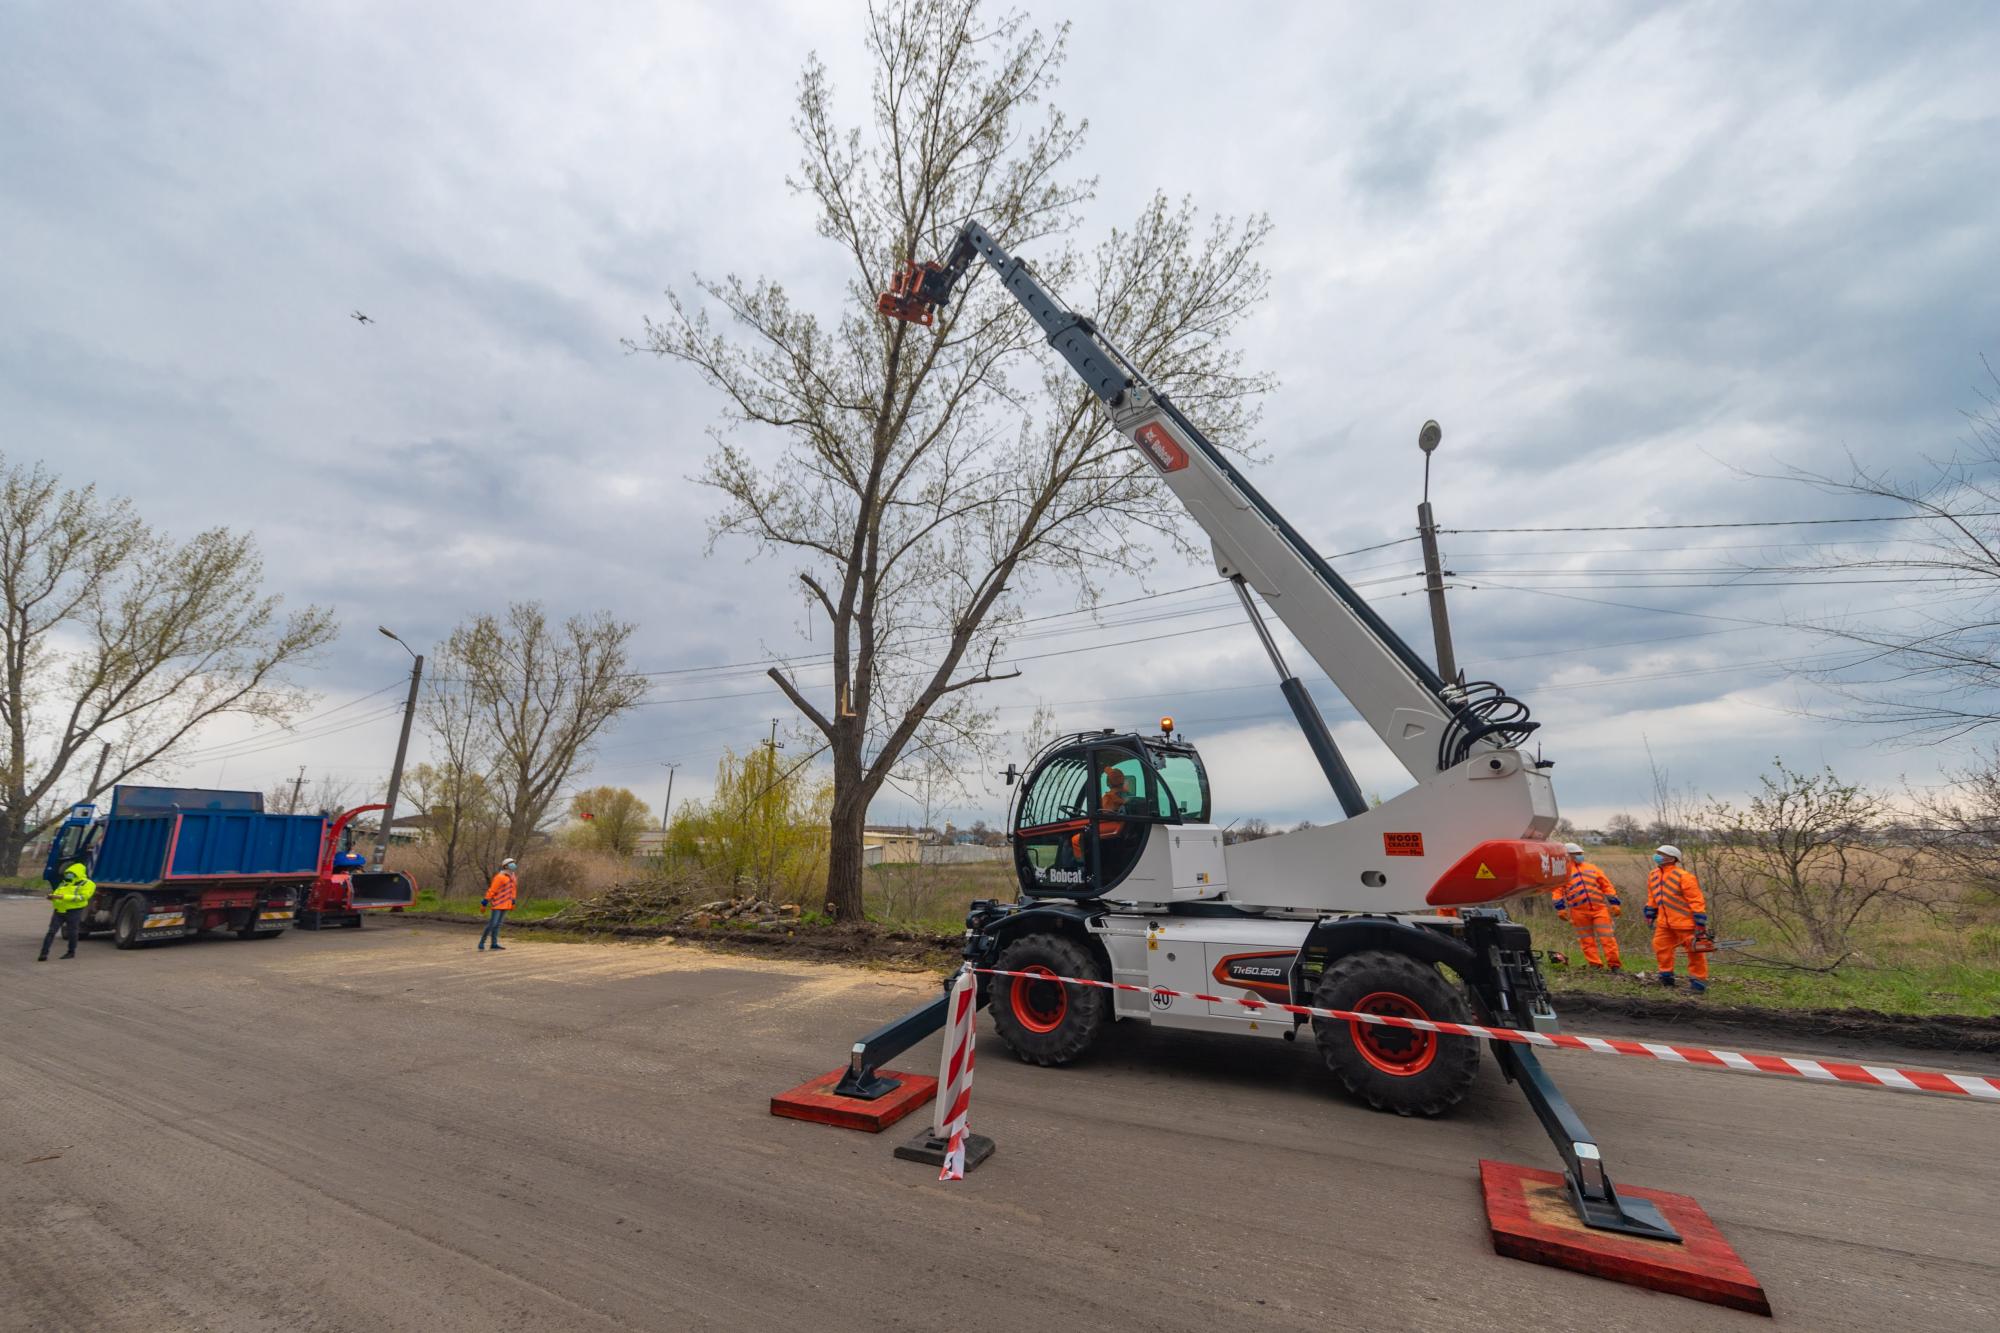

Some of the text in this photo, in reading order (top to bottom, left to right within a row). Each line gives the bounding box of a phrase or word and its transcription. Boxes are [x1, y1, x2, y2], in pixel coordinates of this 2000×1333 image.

[1388, 834, 1419, 842] WOOD
[1050, 868, 1085, 884] Bobcat
[141, 929, 183, 938] VOLVO
[1153, 991, 1170, 1005] 40
